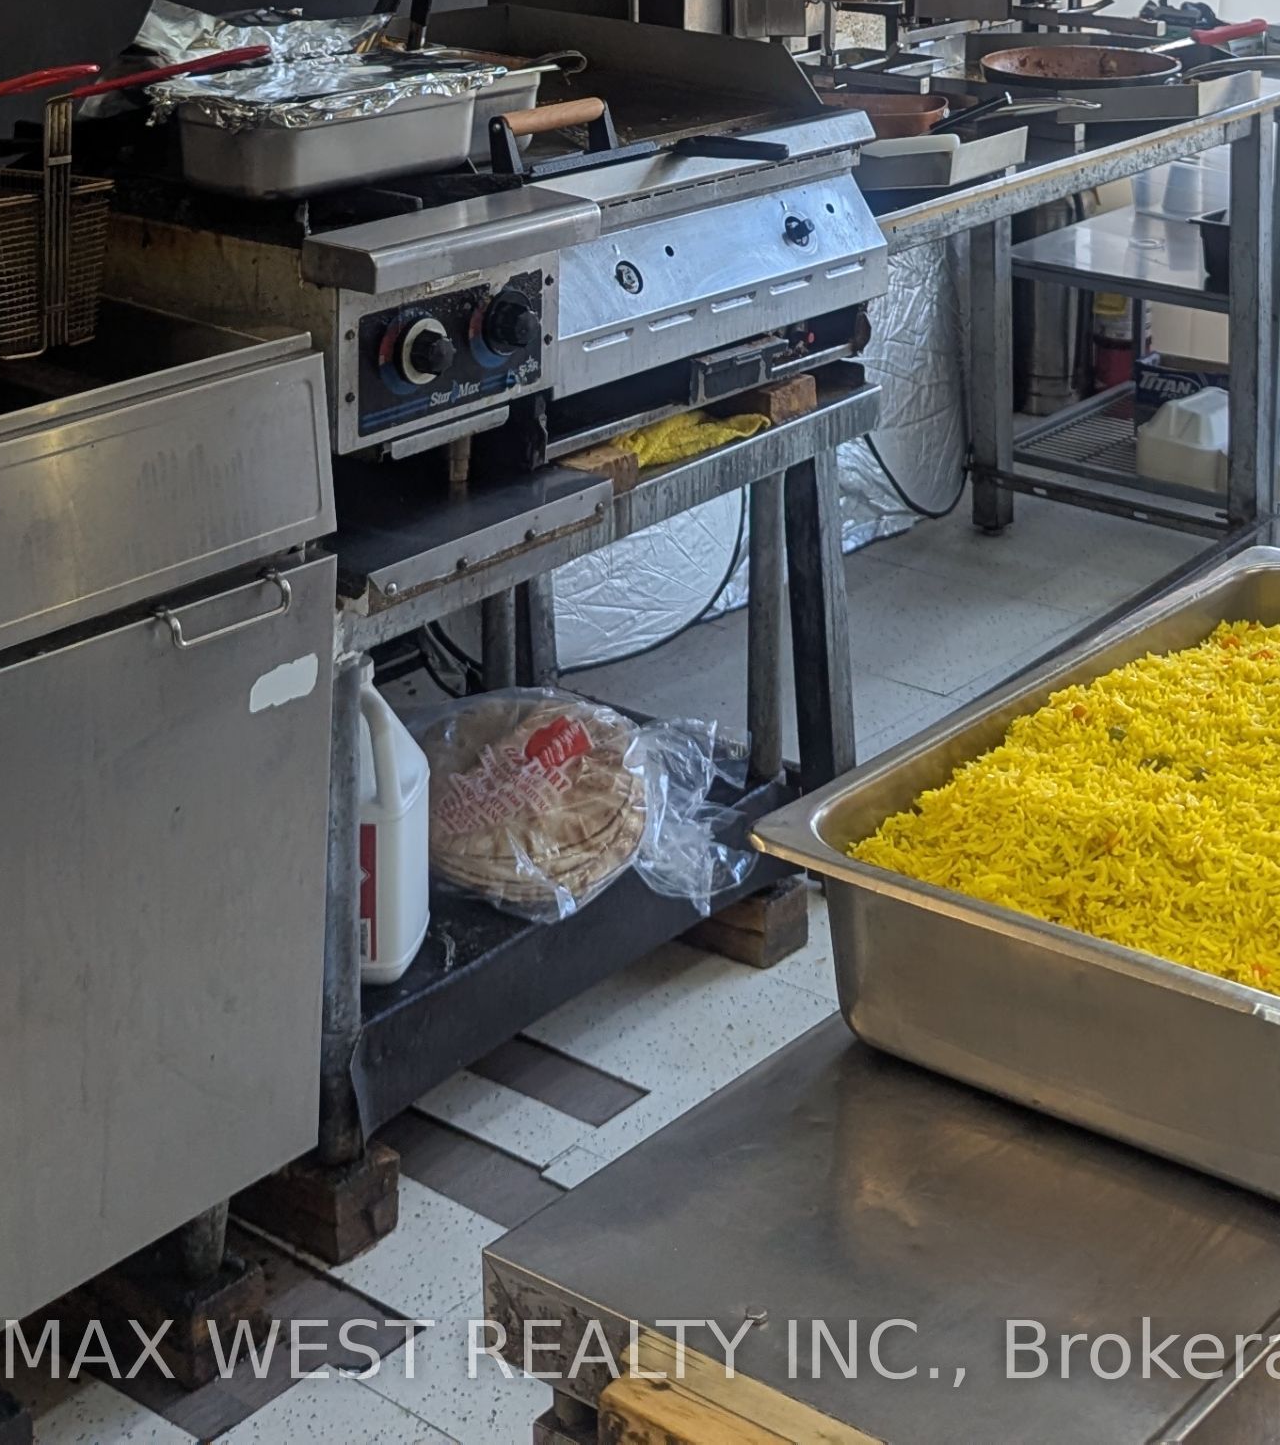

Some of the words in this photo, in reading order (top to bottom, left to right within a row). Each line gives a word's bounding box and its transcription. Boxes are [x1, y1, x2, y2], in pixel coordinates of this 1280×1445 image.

[429, 390, 452, 407] Star
[457, 381, 481, 398] Max
[1138, 369, 1192, 395] TITAN
